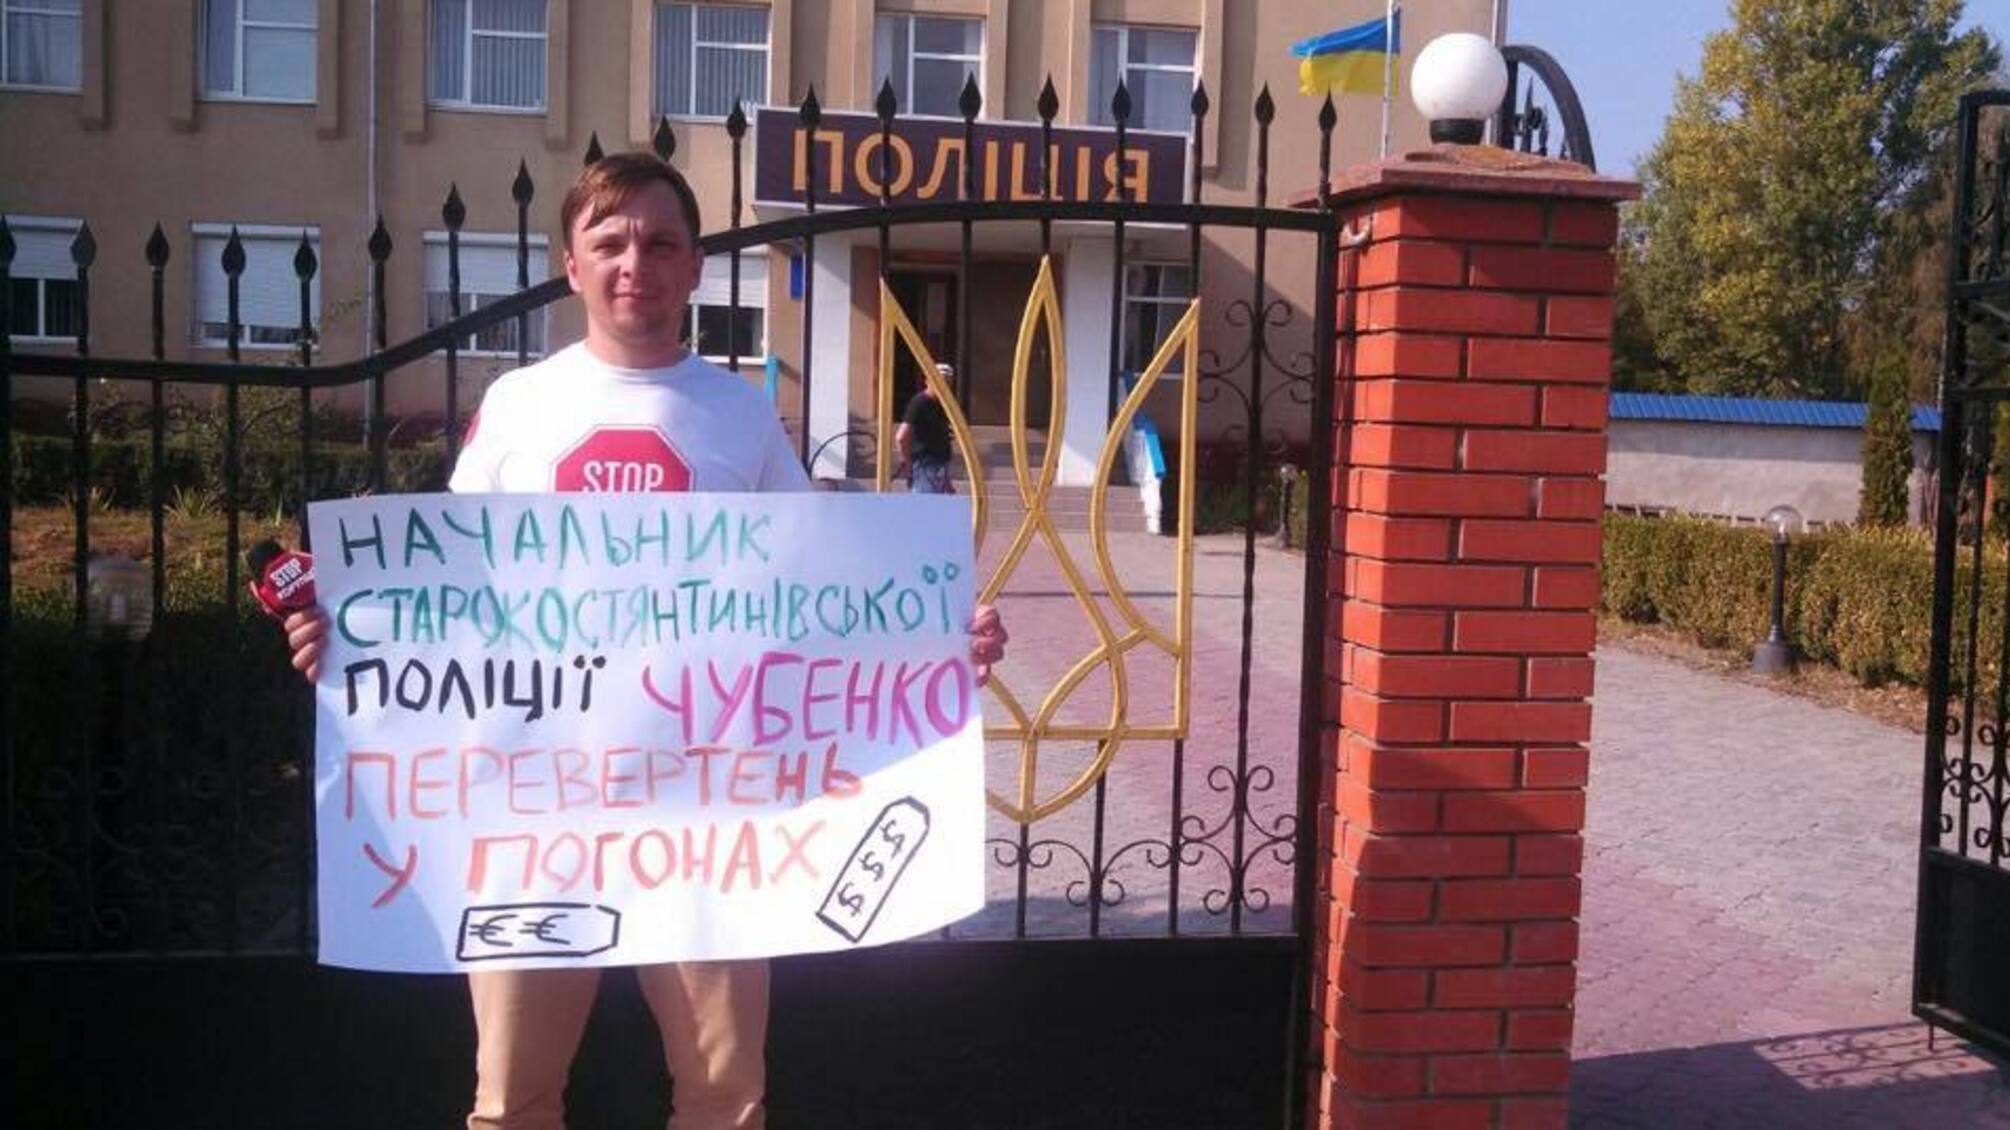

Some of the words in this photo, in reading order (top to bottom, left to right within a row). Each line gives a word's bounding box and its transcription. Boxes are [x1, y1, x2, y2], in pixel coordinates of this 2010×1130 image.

[793, 130, 1150, 203] ПОЛІЦІЯ
[583, 461, 664, 492] STOP
[339, 504, 771, 570] НАЧАЛЬНИК
[337, 563, 959, 652] СТАРОКОСТЯНТИНІВСЬКОЇ
[345, 655, 606, 722] ПОЛІЦІЇ
[642, 651, 969, 748] ЧУБЕНКО
[345, 742, 862, 821] ПЕРЕВЕРТЕНЬ
[363, 842, 418, 909] У
[467, 821, 827, 894] ПОГОНАХ
